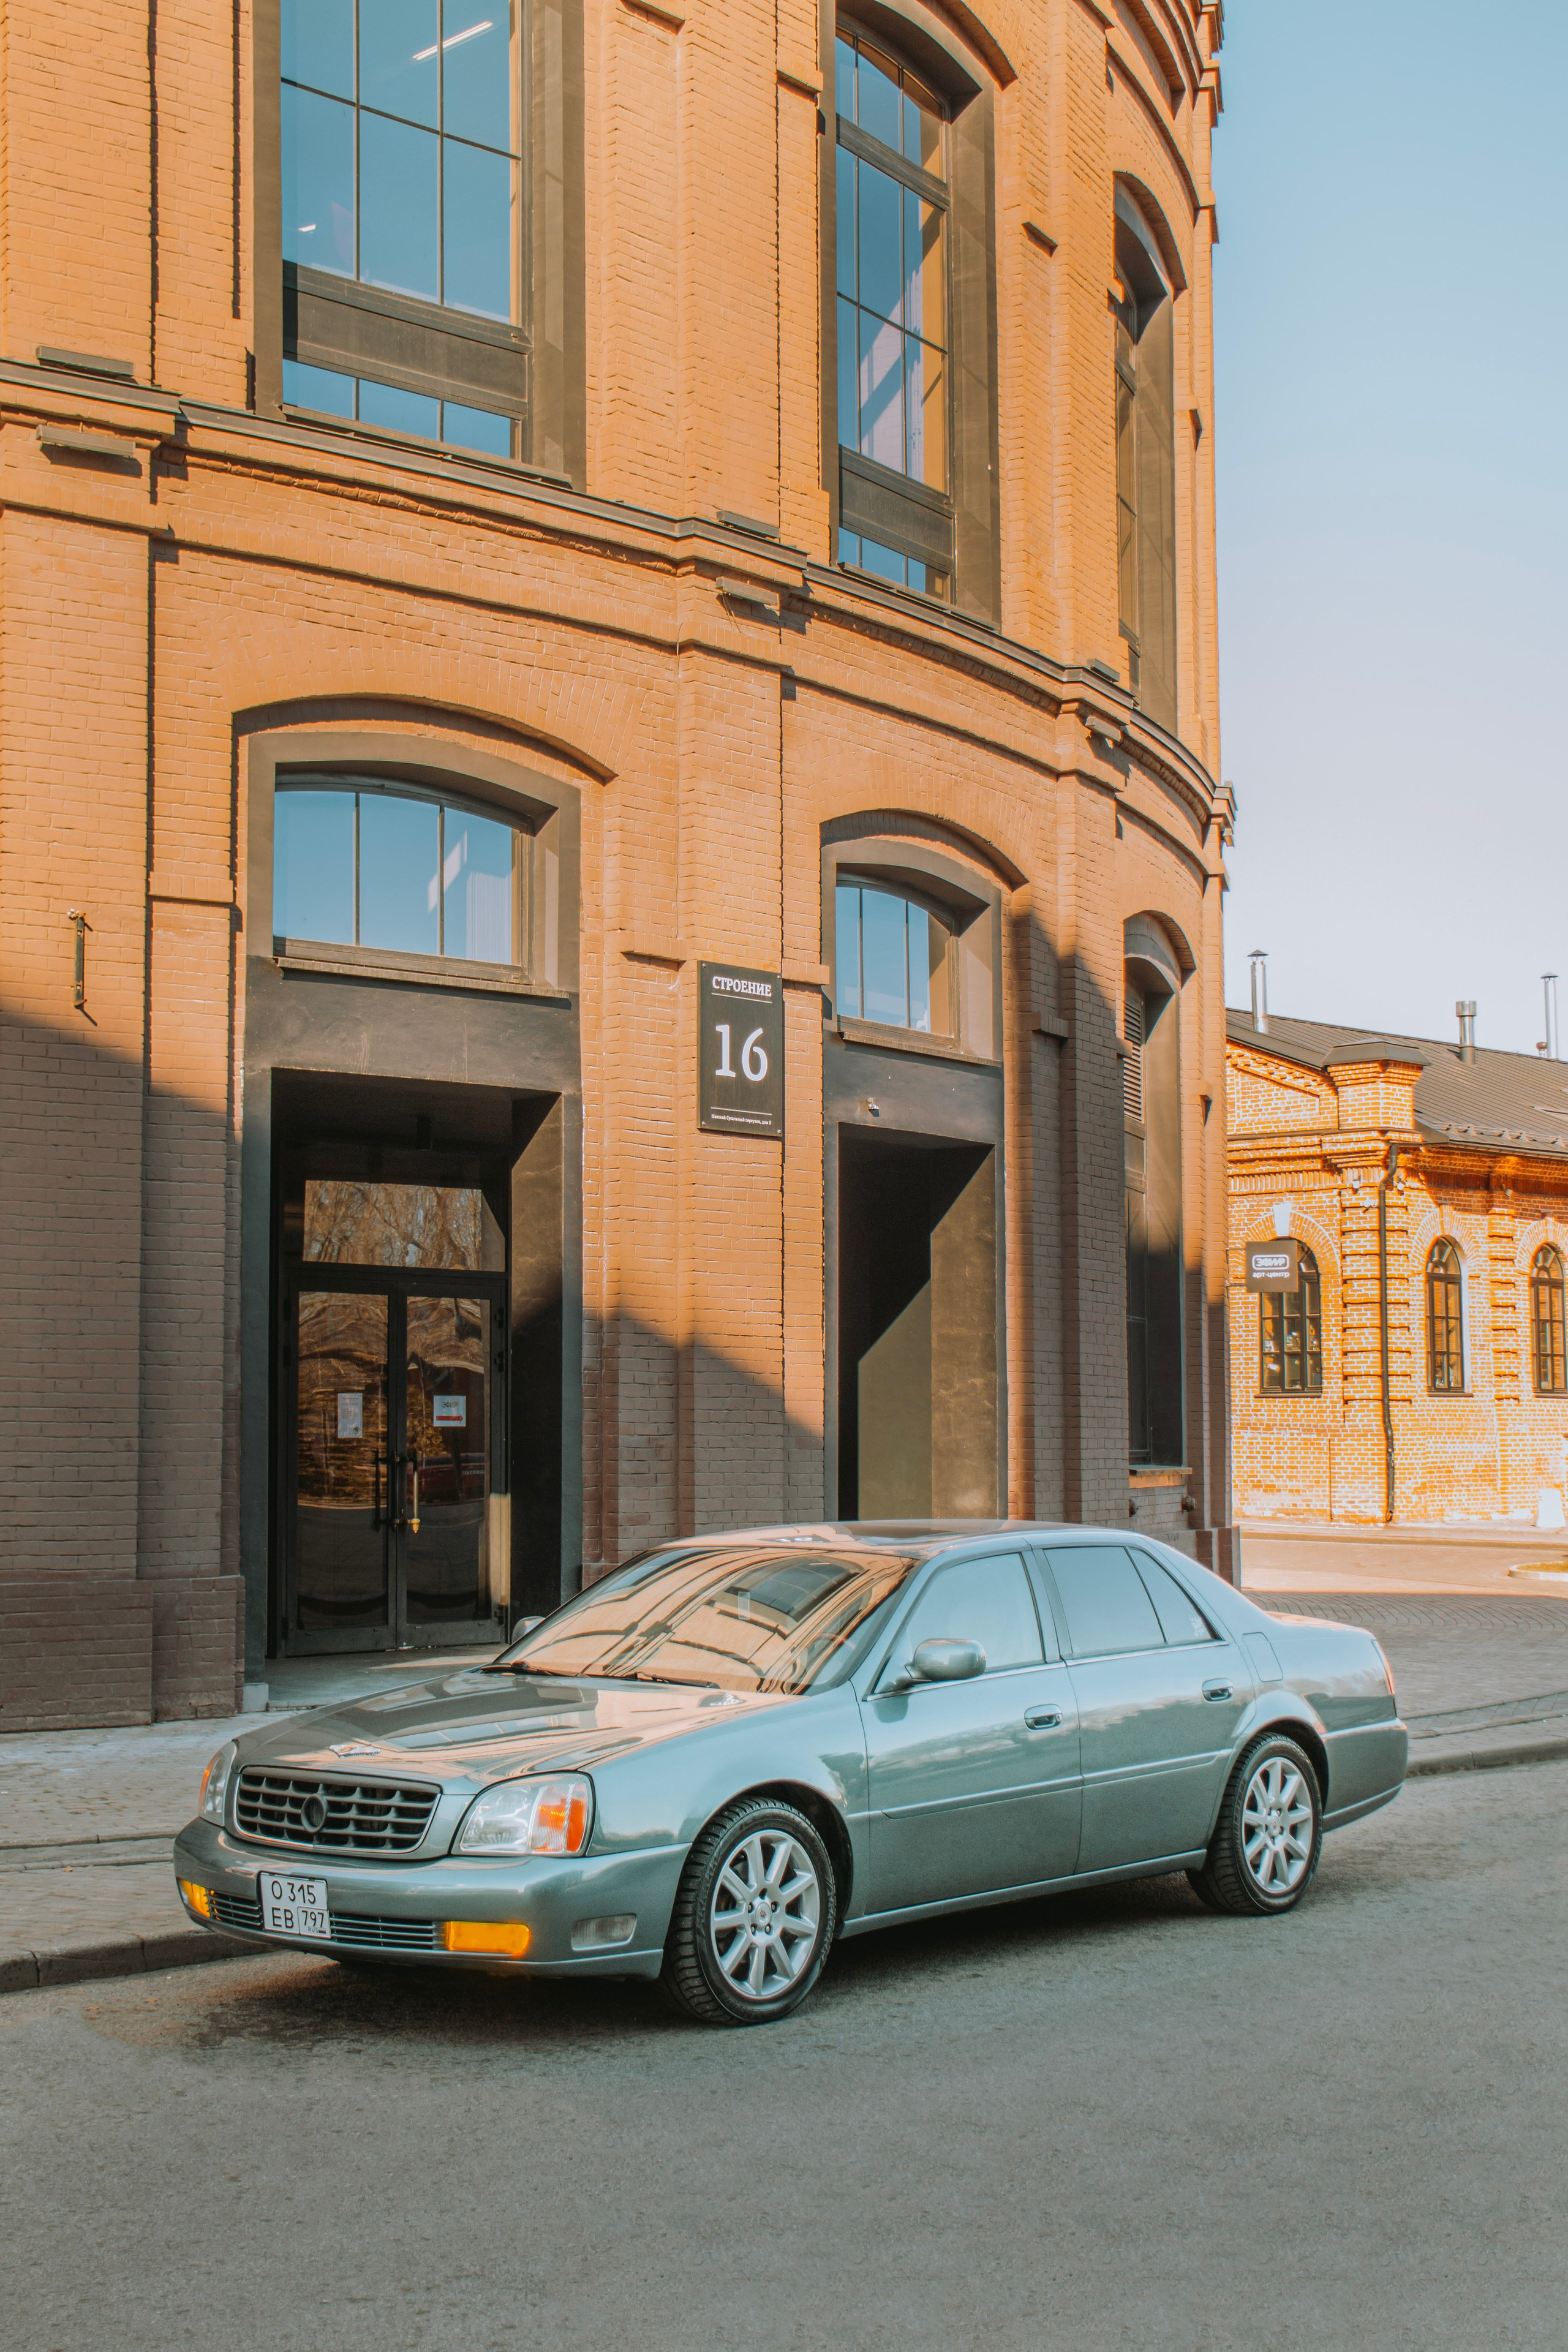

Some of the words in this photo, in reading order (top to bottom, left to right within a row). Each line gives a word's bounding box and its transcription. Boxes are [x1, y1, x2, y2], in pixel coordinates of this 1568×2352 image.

[712, 976, 772, 997] СТРОЕНИЕ
[715, 1024, 768, 1082] 16
[287, 1882, 316, 1904] 315
[301, 1910, 324, 1928] 797
